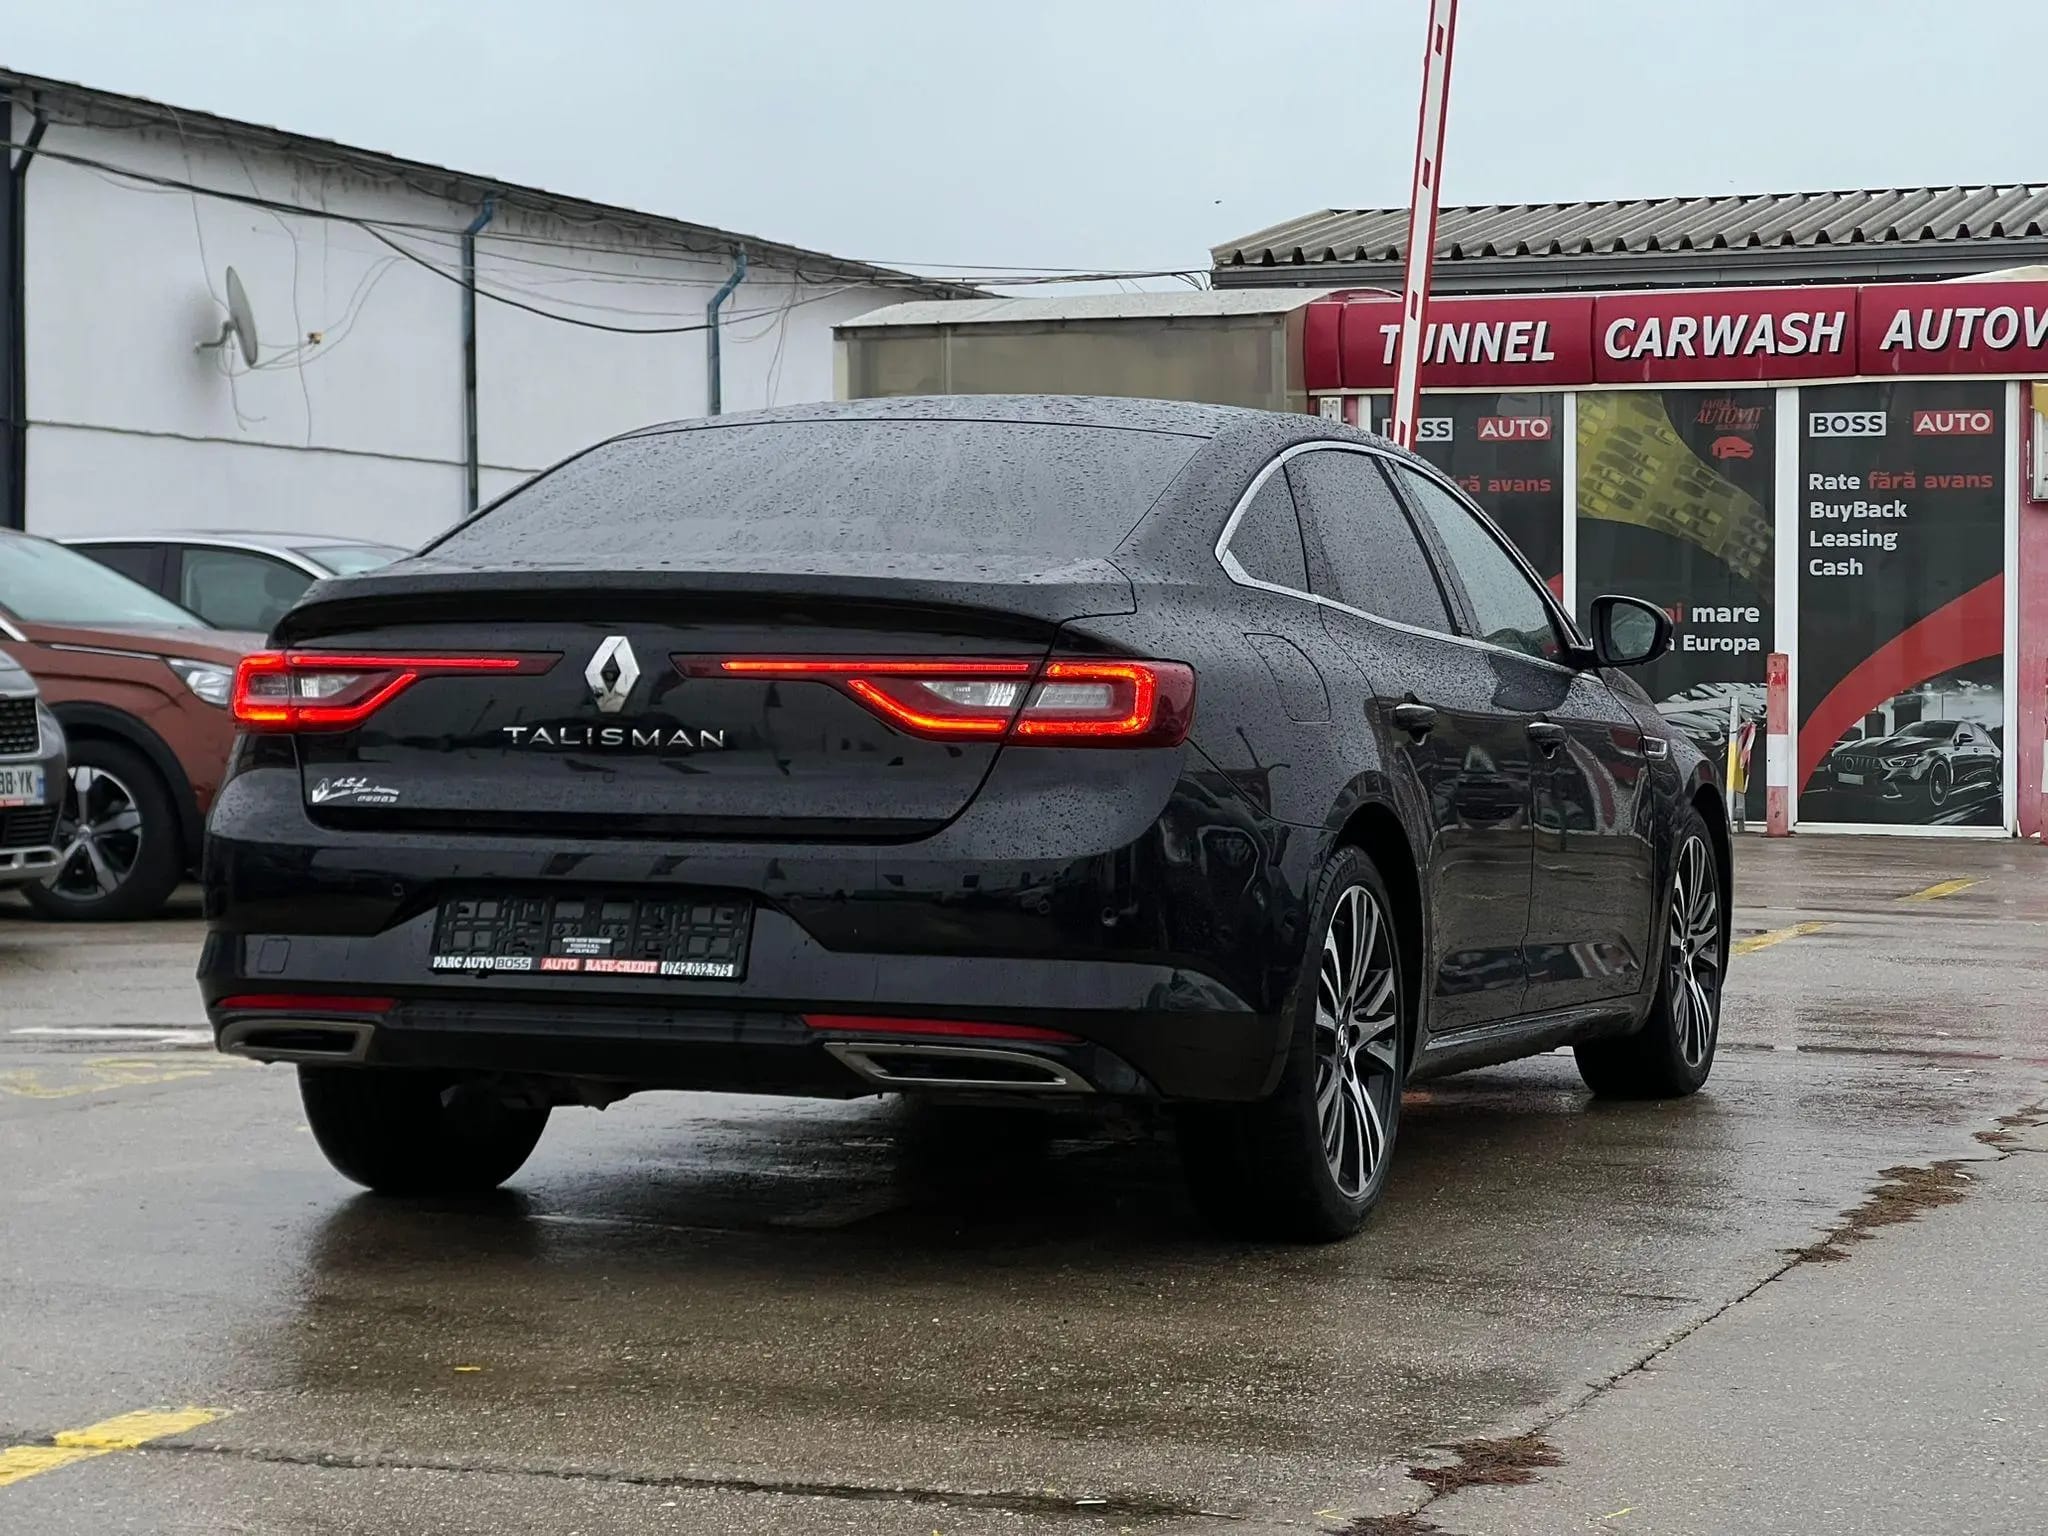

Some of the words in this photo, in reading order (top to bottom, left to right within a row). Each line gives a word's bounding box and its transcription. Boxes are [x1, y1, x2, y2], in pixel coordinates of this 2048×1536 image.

[1604, 311, 1845, 359] CARWASH
[1480, 419, 1549, 438] AUTO
[1813, 415, 1883, 433] BOSS
[1916, 413, 1991, 432] AUTO
[1487, 478, 1551, 492] avans
[1809, 473, 1861, 490] Rate
[1868, 471, 1916, 489] fără
[1924, 475, 1993, 489] avans
[1810, 500, 1908, 522] BuyBack
[1810, 529, 1898, 551] Leasing
[1809, 558, 1863, 576] Cash
[1692, 606, 1760, 623] mare
[1683, 634, 1760, 655] Europa
[503, 726, 724, 748] TALISMAN
[433, 956, 462, 969] PARC
[462, 957, 494, 970] AUTO
[497, 958, 530, 970] BOSS
[543, 959, 577, 971] AUTO
